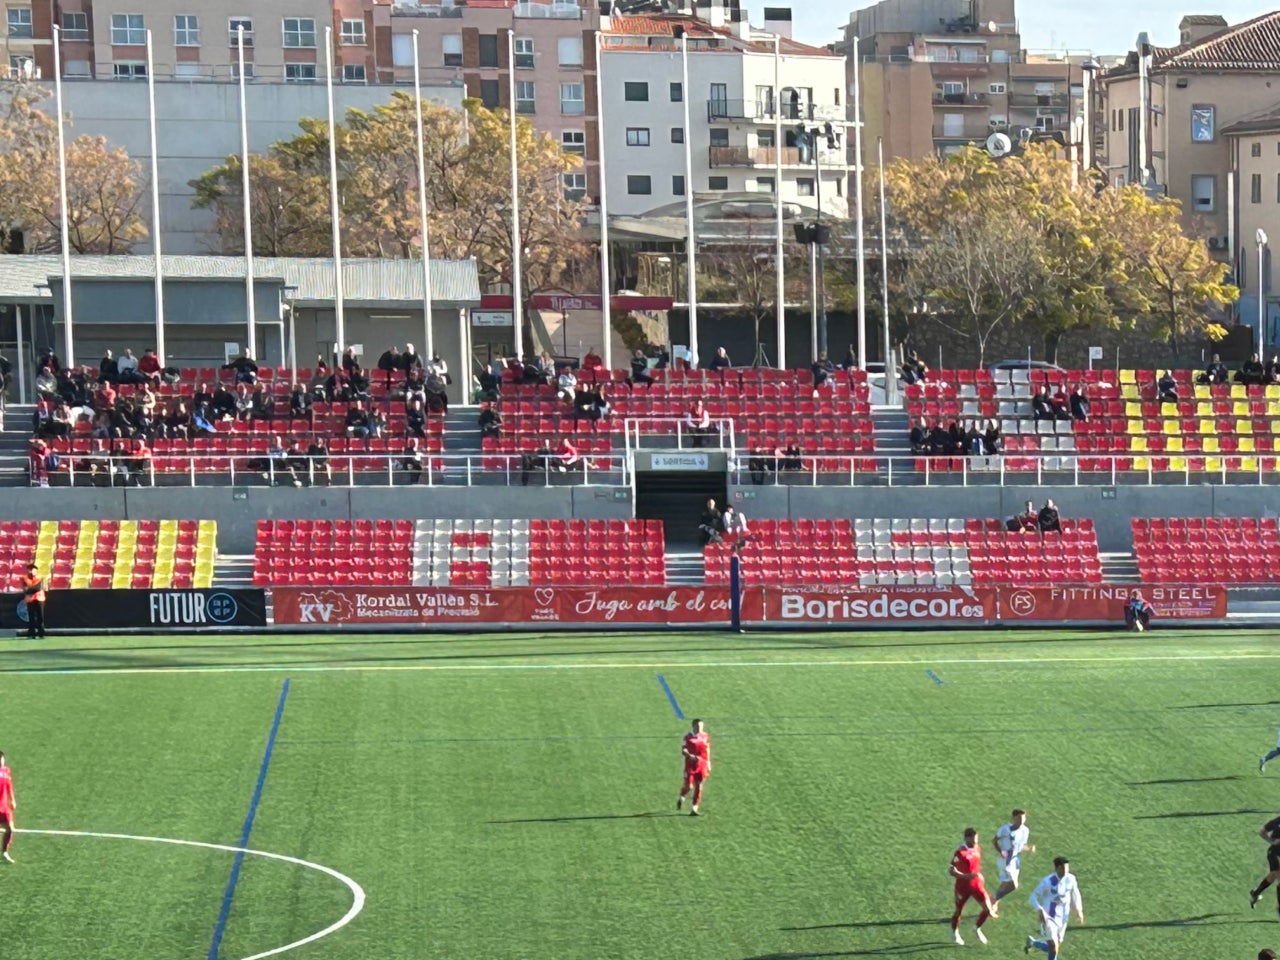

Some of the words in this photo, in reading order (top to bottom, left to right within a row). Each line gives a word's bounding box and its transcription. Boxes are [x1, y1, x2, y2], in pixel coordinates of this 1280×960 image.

[355, 593, 411, 607] Kordal
[470, 593, 499, 607] S.L.
[576, 590, 633, 620] Juga
[638, 590, 681, 612] amb
[687, 590, 706, 612] el
[1051, 588, 1137, 600] FITTING
[1153, 587, 1216, 600] STEEL
[150, 592, 206, 624] FUTUR
[299, 602, 332, 623] KV
[781, 593, 984, 619] Borisdecor.es
